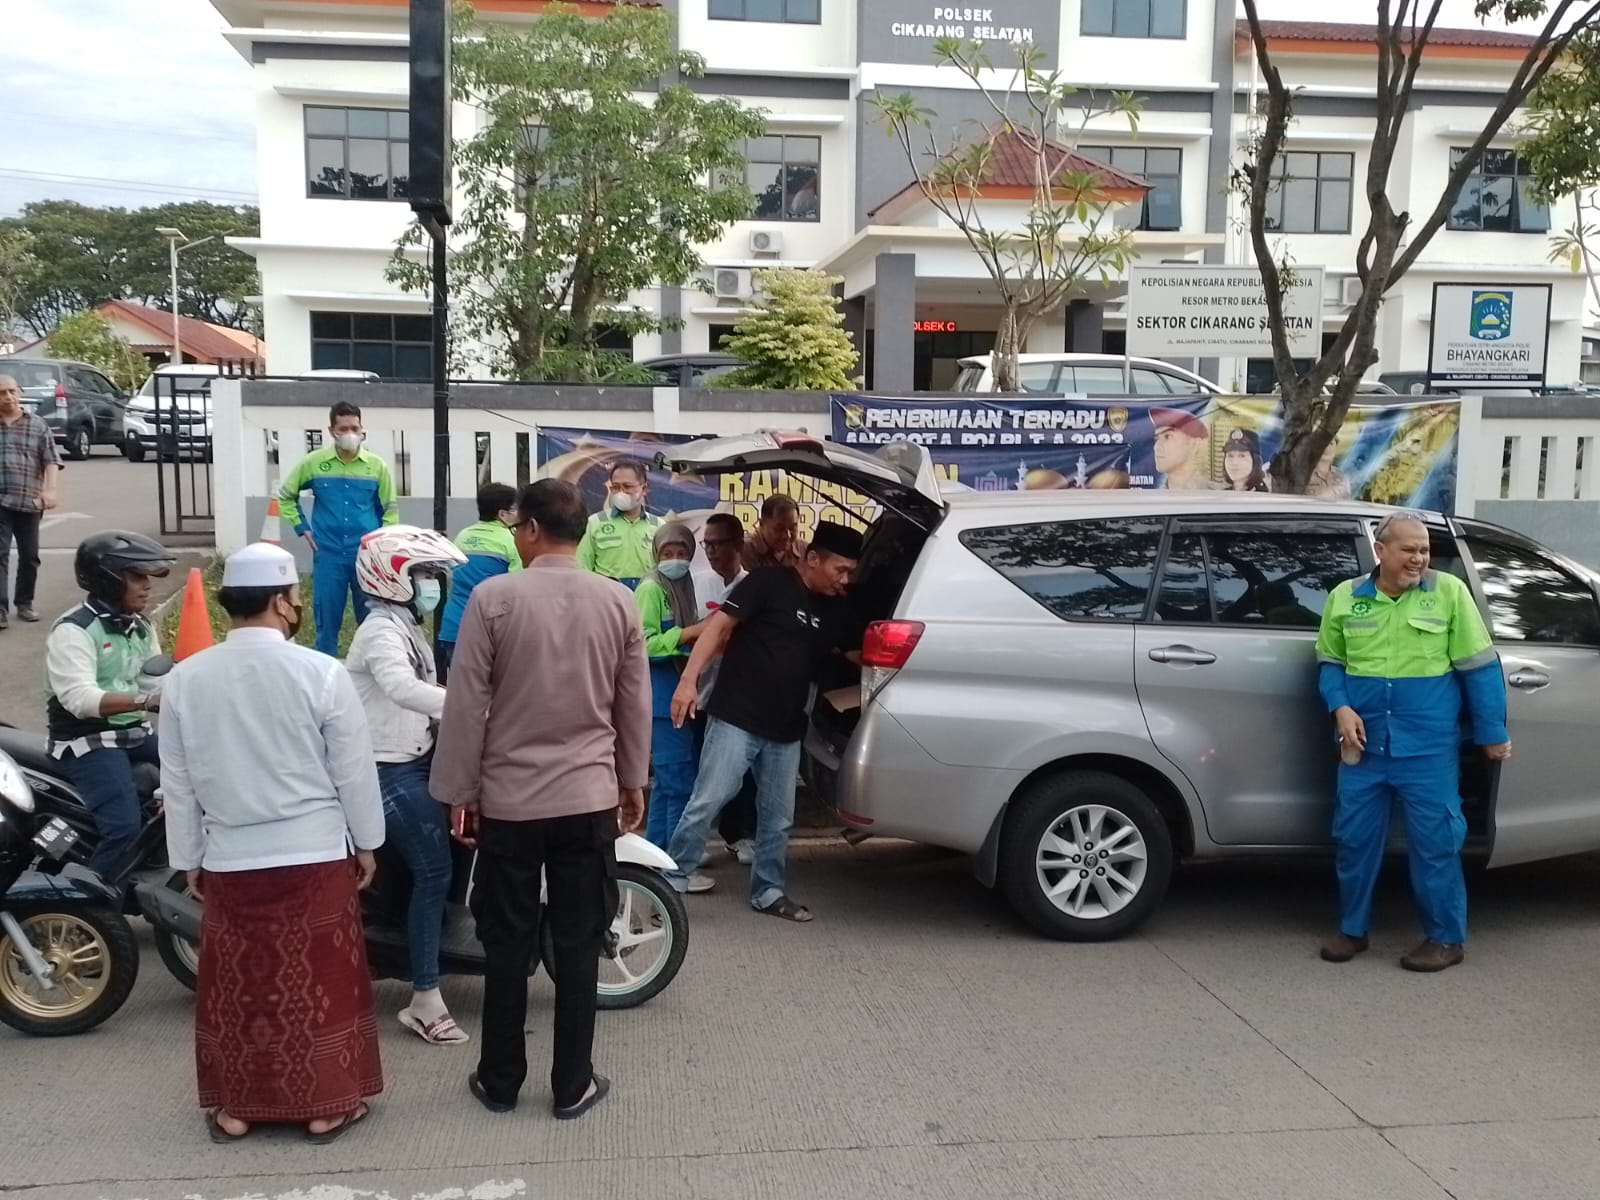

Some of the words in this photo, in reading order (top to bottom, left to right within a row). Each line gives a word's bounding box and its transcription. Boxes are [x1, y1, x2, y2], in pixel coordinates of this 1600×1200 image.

[934, 8, 993, 22] POLSEK
[891, 22, 965, 39] CIKARANG
[973, 26, 1033, 41] SELATAN
[1141, 277, 1190, 288] KEPOLISIAN
[1192, 277, 1225, 288] NEGARA
[1227, 277, 1264, 288] REPUBLI
[1181, 296, 1209, 306] RESOR
[1210, 296, 1239, 306] METRO
[1241, 296, 1268, 306] BEKAS
[914, 321, 945, 331] OLSEK
[1136, 316, 1186, 329] SEKTOR
[1190, 316, 1255, 329] CIKARANG
[1259, 316, 1313, 329] SATAN
[1447, 349, 1530, 362] BHAYANGKARI
[865, 408, 1003, 429] PENERIMAAN
[1009, 409, 1107, 430] TERPADU
